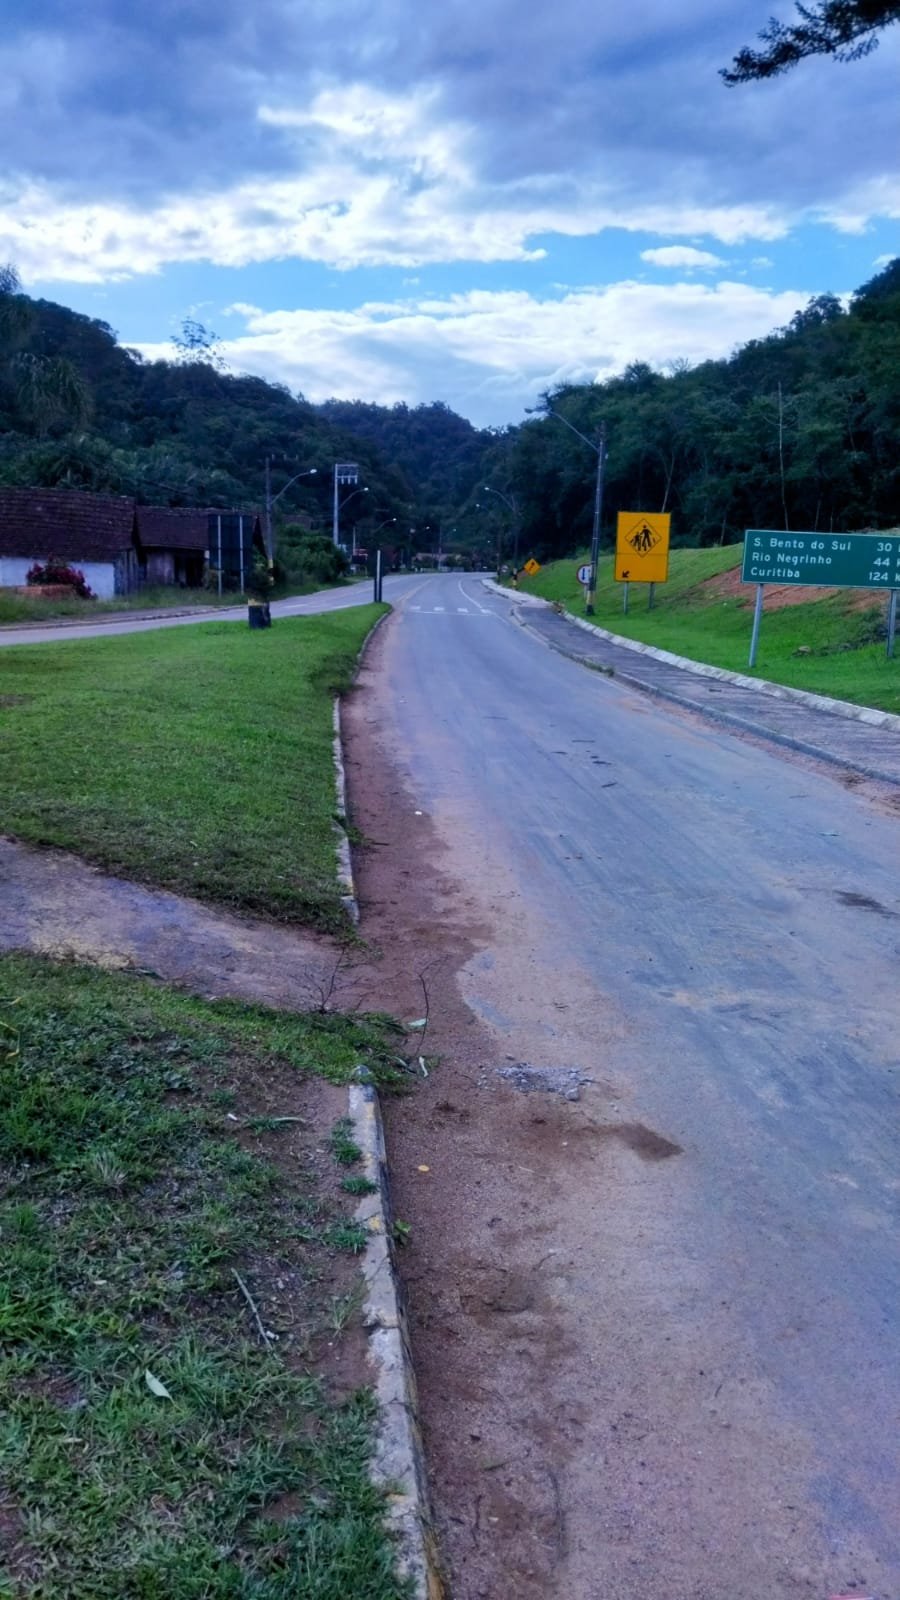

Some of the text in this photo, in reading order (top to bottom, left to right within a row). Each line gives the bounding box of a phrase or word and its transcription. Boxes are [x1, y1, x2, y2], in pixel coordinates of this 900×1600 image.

[754, 537, 763, 547] S.
[770, 538, 804, 549] Bento
[811, 541, 824, 550] do
[832, 541, 851, 551] Sul
[877, 543, 892, 552] 30
[752, 552, 771, 562] Rio
[777, 553, 832, 565] Negrinho
[873, 557, 890, 567] 44
[751, 567, 800, 577] Curitiba
[869, 572, 888, 581] 124
